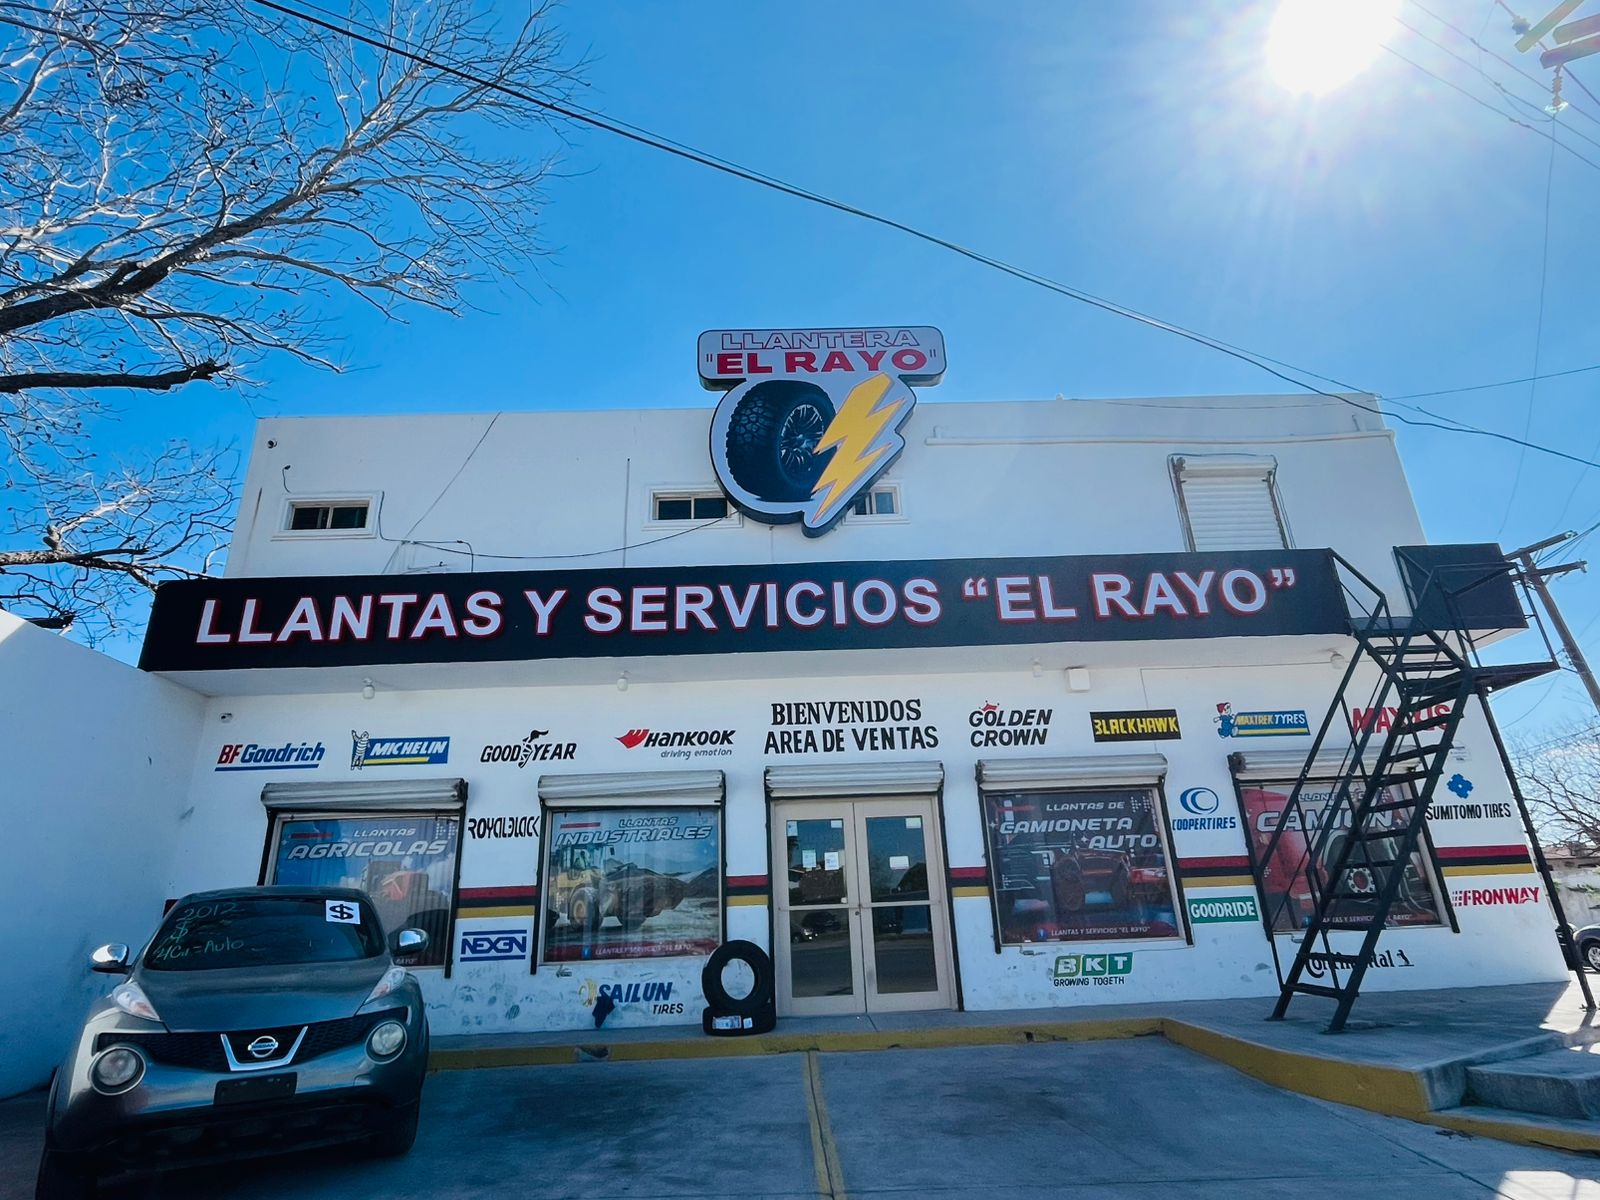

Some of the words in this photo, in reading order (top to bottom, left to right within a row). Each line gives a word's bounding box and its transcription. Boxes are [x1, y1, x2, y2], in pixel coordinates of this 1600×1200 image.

[721, 330, 920, 350] LLANTERA
[705, 352, 773, 374] "EL
[785, 348, 937, 373] RAYO"
[195, 590, 503, 644] LLANTAS
[523, 589, 567, 635] Y
[583, 577, 942, 633] SERVICIOS
[771, 698, 922, 726] BIENVENIDOS
[968, 708, 1053, 728] GOLDEN
[1274, 713, 1306, 725] TYRES
[1093, 716, 1179, 735] BLACKHAWK
[764, 730, 818, 755] AREA
[822, 729, 845, 753] DE
[851, 725, 939, 751] VENTAS
[970, 728, 1048, 748] CROWN
[369, 741, 448, 757] MICHELIN
[660, 750, 691, 760] driving
[694, 749, 732, 757] emotion
[1046, 802, 1104, 812] LLANTAS
[1107, 801, 1125, 809] DE
[1425, 804, 1482, 820] SUMITOMO
[1484, 802, 1512, 819] TIRES
[618, 817, 679, 828] LLANTAS
[1000, 817, 1133, 834] CAMIONETA
[354, 828, 416, 838] LLANTAS
[555, 826, 712, 847] INDUSTRIALES
[1088, 834, 1158, 849] AUTO
[287, 839, 448, 860] AGRICOLAS
[1462, 887, 1540, 906] FRONWAY
[1190, 901, 1256, 918] GOODRIDE
[461, 936, 527, 954] NEXEN
[1057, 956, 1128, 974] BKT
[1053, 977, 1089, 987] GROWING
[1093, 976, 1125, 986] TOGETH
[599, 982, 673, 1003] SAILUN
[653, 1003, 684, 1015] TIRES
